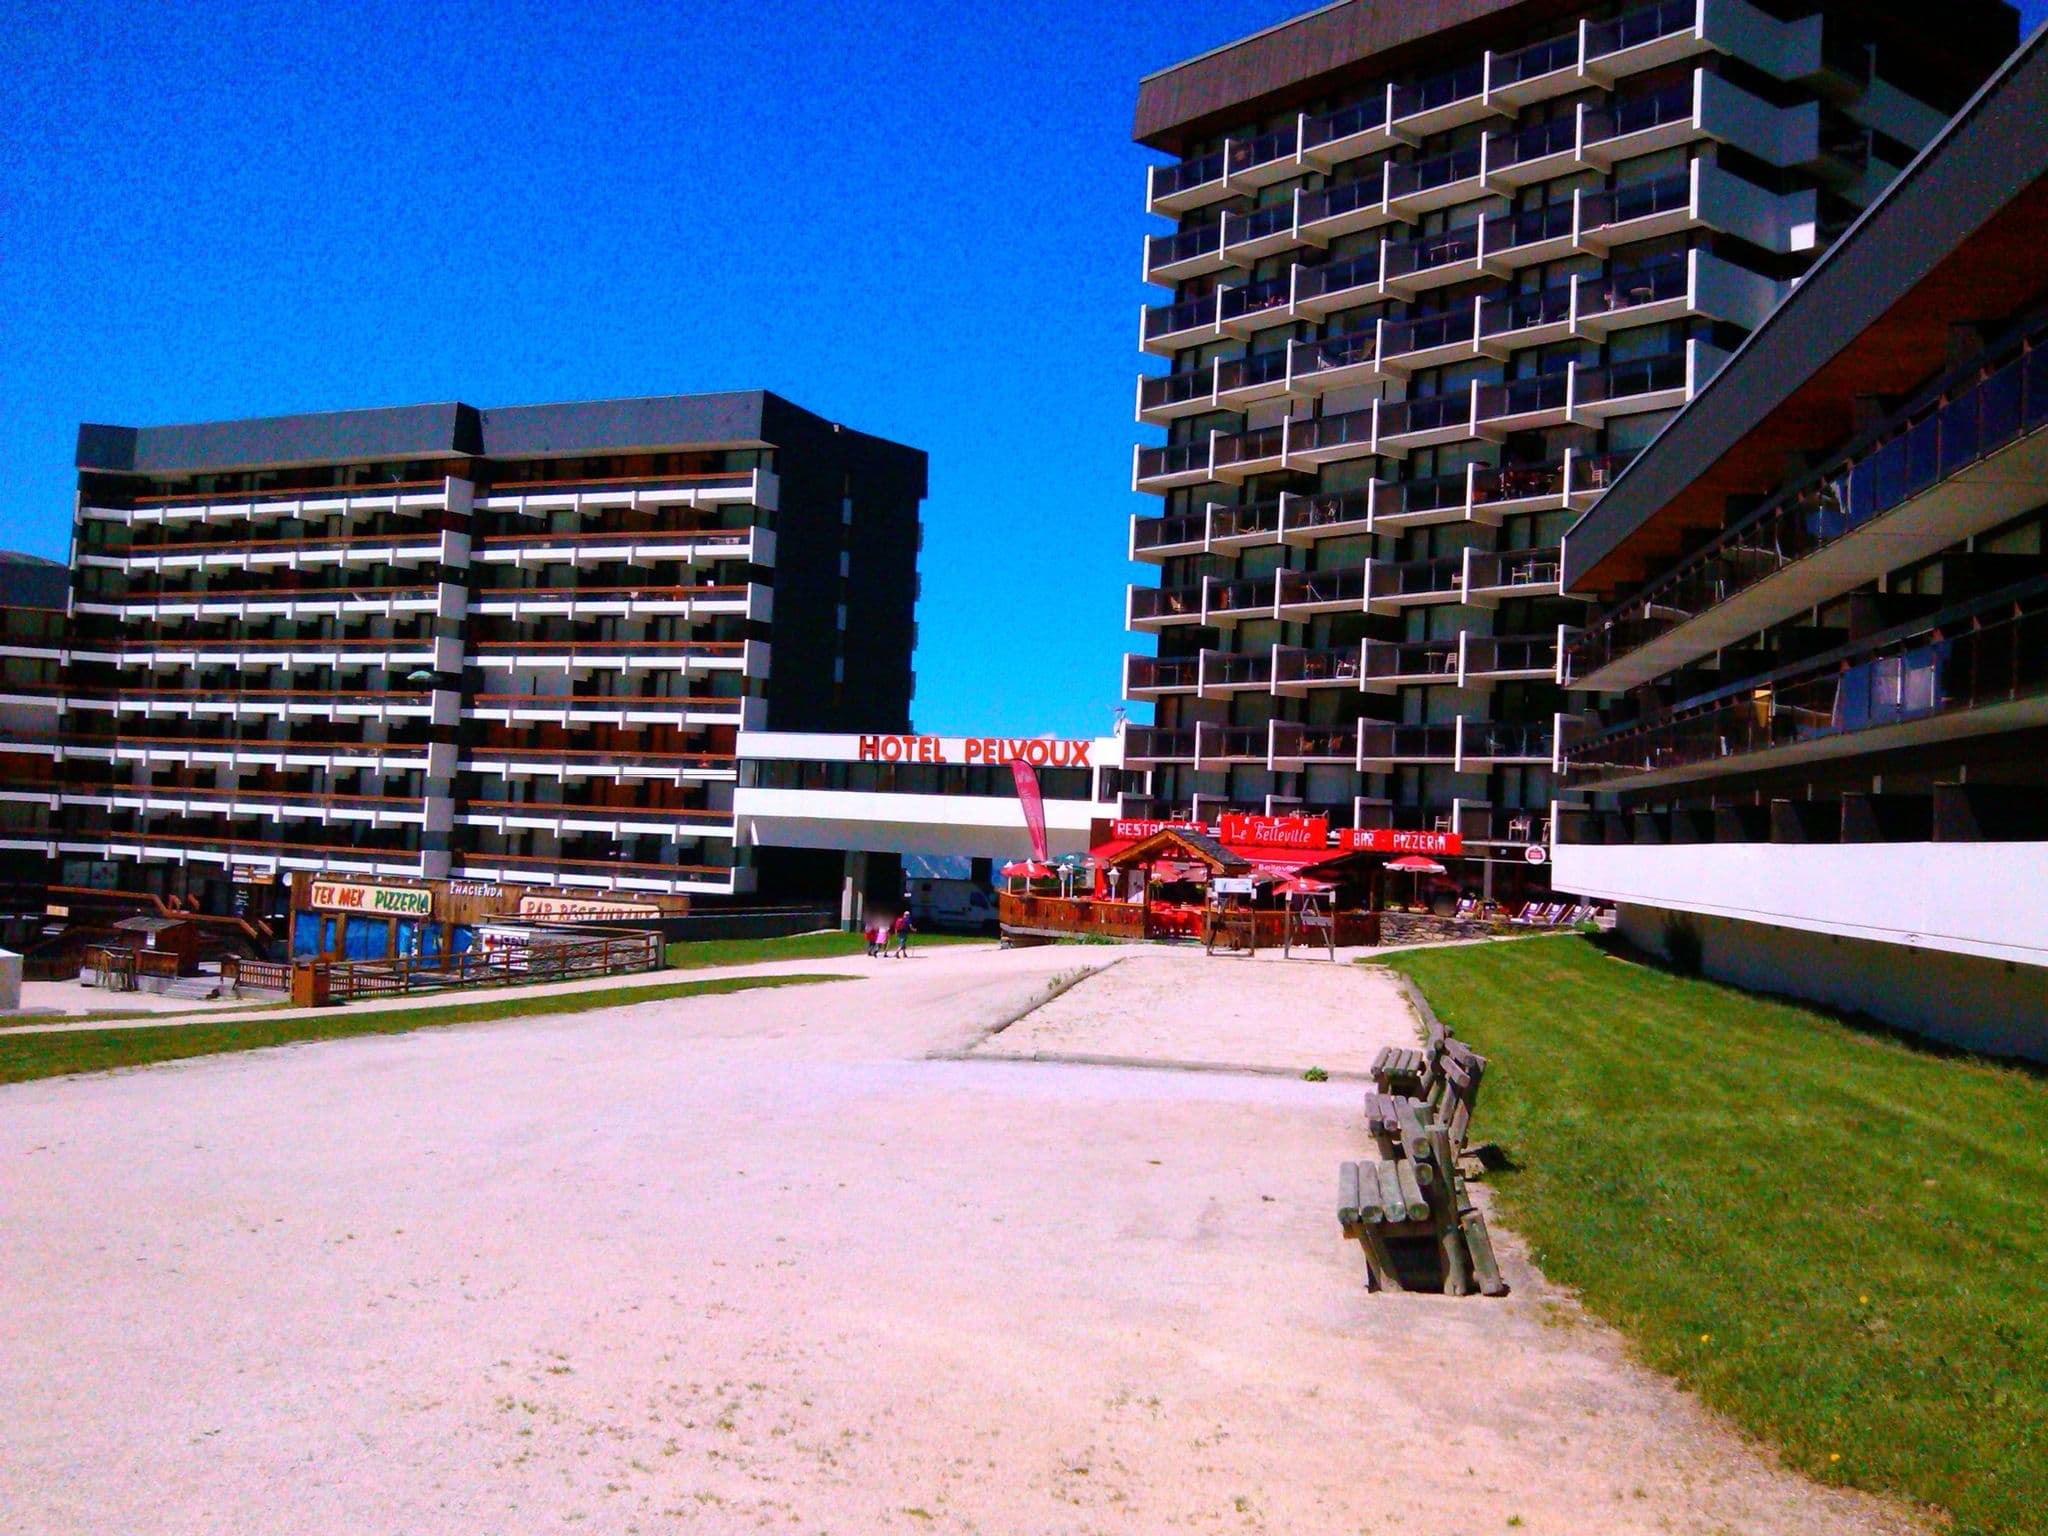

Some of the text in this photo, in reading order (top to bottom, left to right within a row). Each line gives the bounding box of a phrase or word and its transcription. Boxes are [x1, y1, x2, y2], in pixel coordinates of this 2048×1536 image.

[859, 735, 1091, 767] HOTEL PELVOUX
[1117, 823, 1201, 837] RESTAT
[1231, 821, 1311, 842] Le Belleville
[1353, 832, 1374, 847] BAR
[1393, 833, 1446, 851] PIZZERIA
[314, 886, 429, 913] TEX MEX PIZZERIA
[526, 901, 552, 920] BAR
